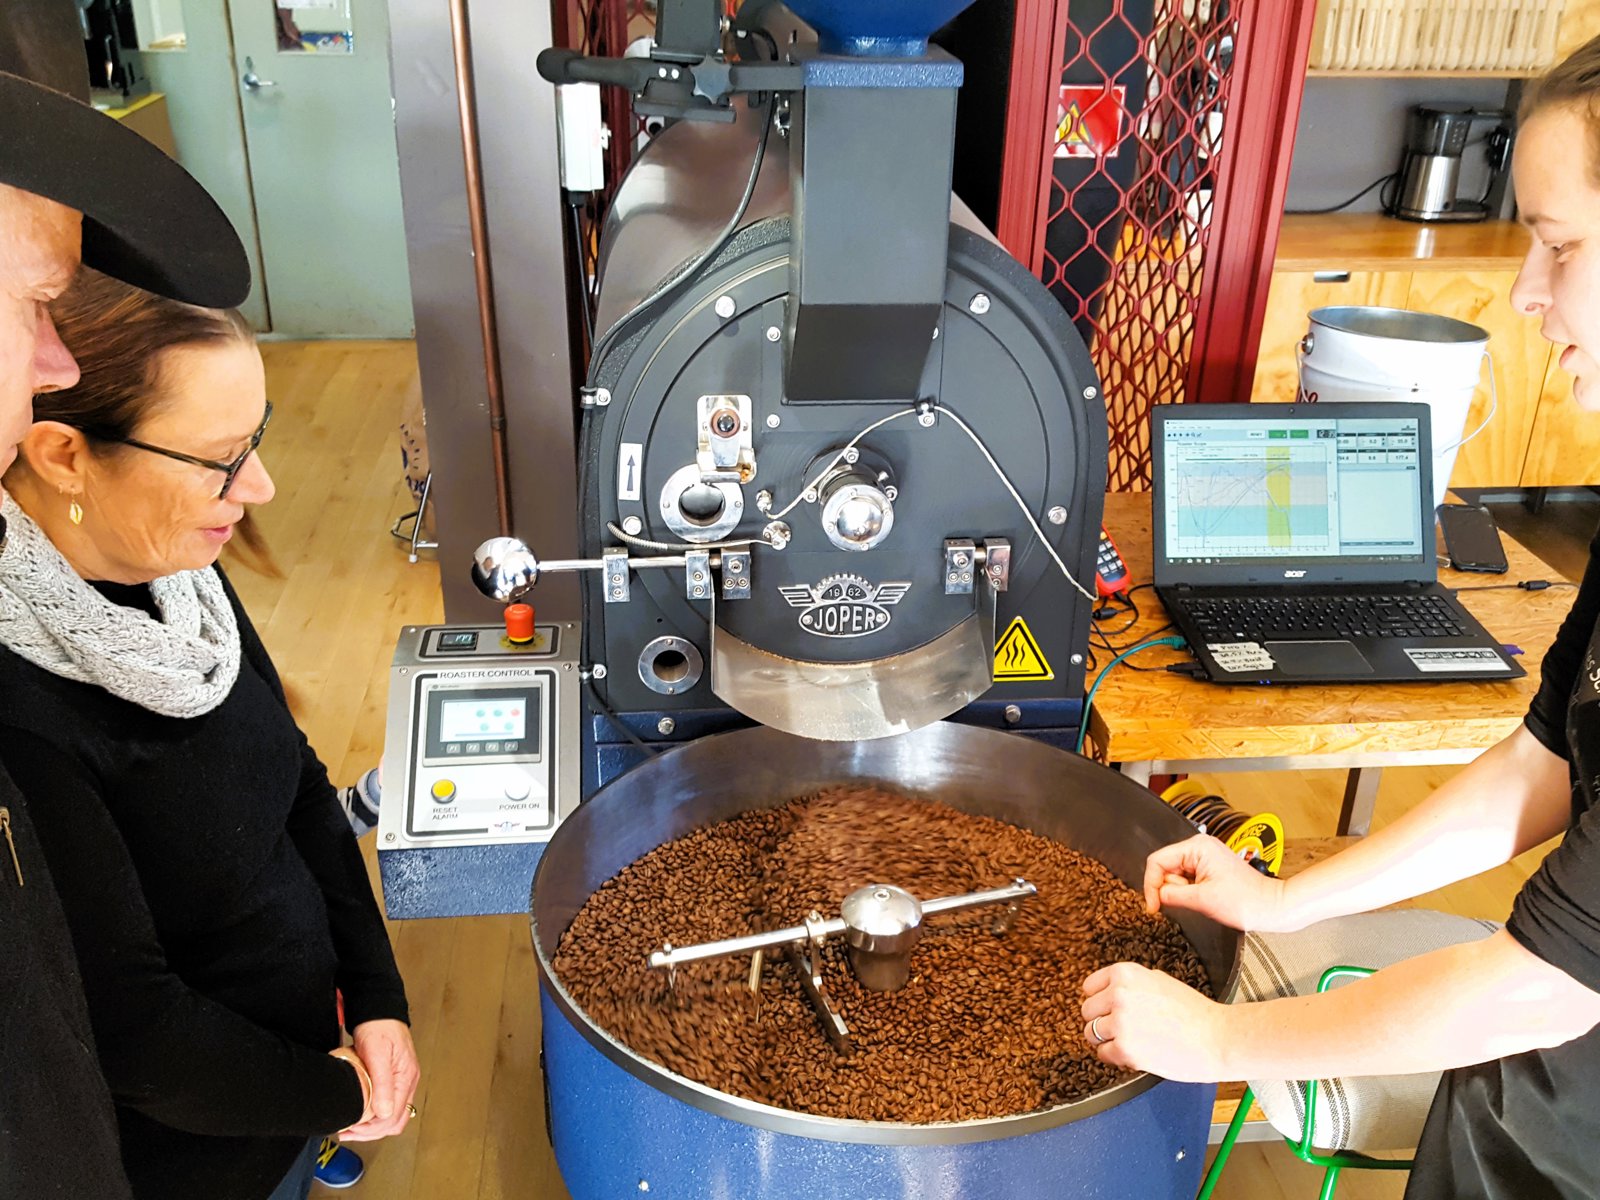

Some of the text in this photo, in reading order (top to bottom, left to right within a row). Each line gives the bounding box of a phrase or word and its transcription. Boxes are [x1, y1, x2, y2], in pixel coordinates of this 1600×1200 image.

[847, 588, 861, 597] 62
[814, 605, 876, 632] JOPER
[440, 669, 533, 679] ROASTER CONTROL
[432, 813, 459, 821] ALARM
